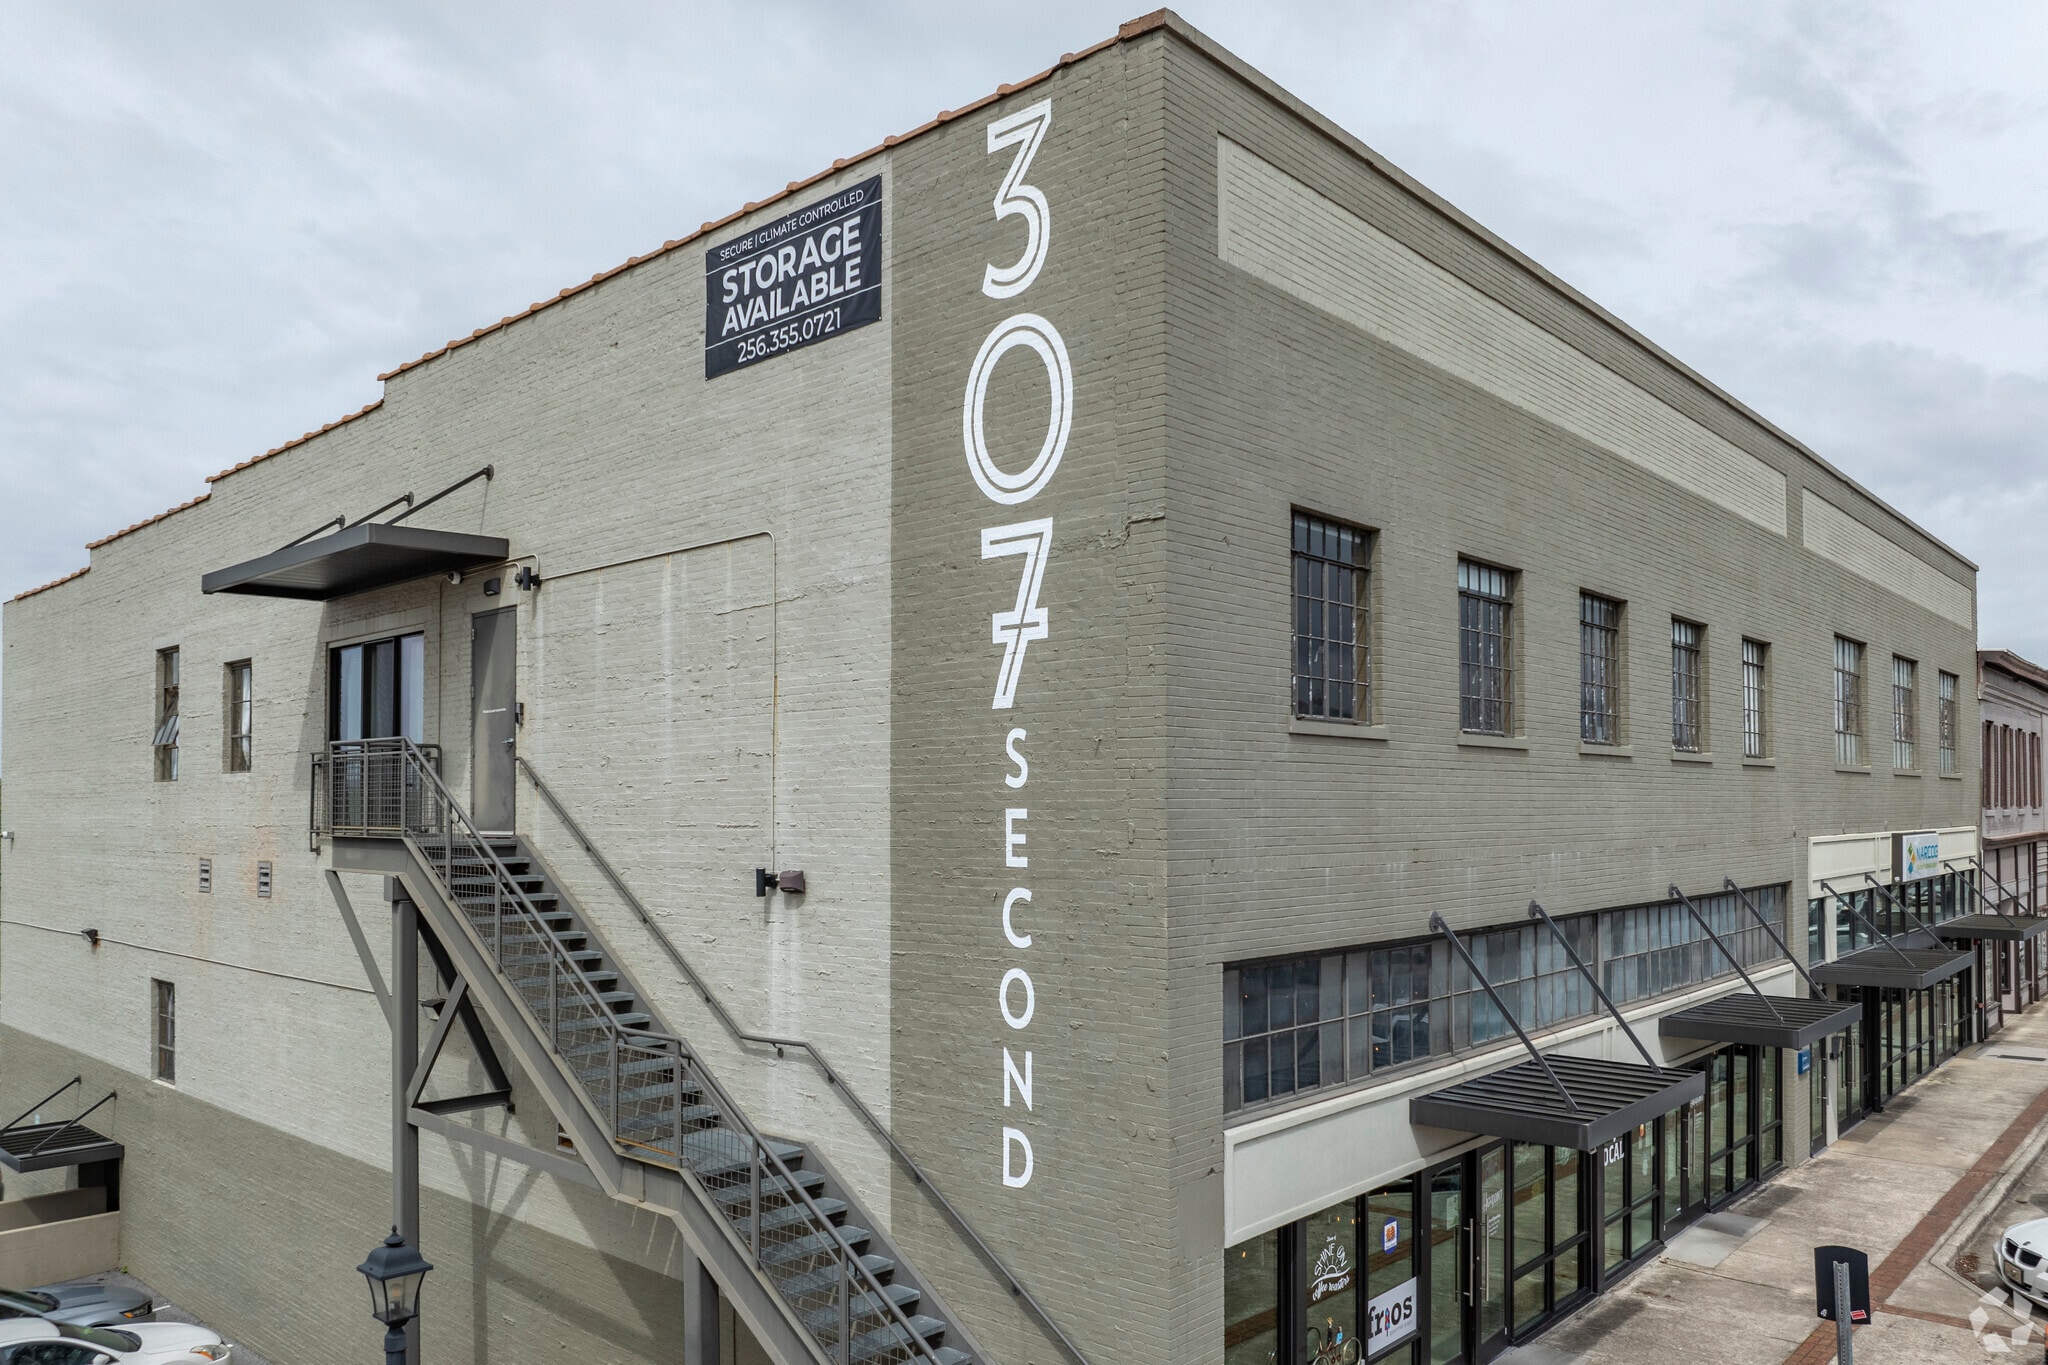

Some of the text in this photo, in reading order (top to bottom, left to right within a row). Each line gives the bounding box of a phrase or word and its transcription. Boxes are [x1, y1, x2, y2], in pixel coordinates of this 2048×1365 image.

[720, 239, 753, 261] SECURE
[759, 220, 797, 244] CLIMATE
[798, 189, 864, 227] CONTROLLED
[722, 215, 862, 304] STORAGE
[721, 256, 861, 337] AVAILABLE
[737, 307, 841, 363] 256.355.0721
[963, 98, 1073, 1189] 307 SECOND
[1314, 1243, 1335, 1276] SHINE
